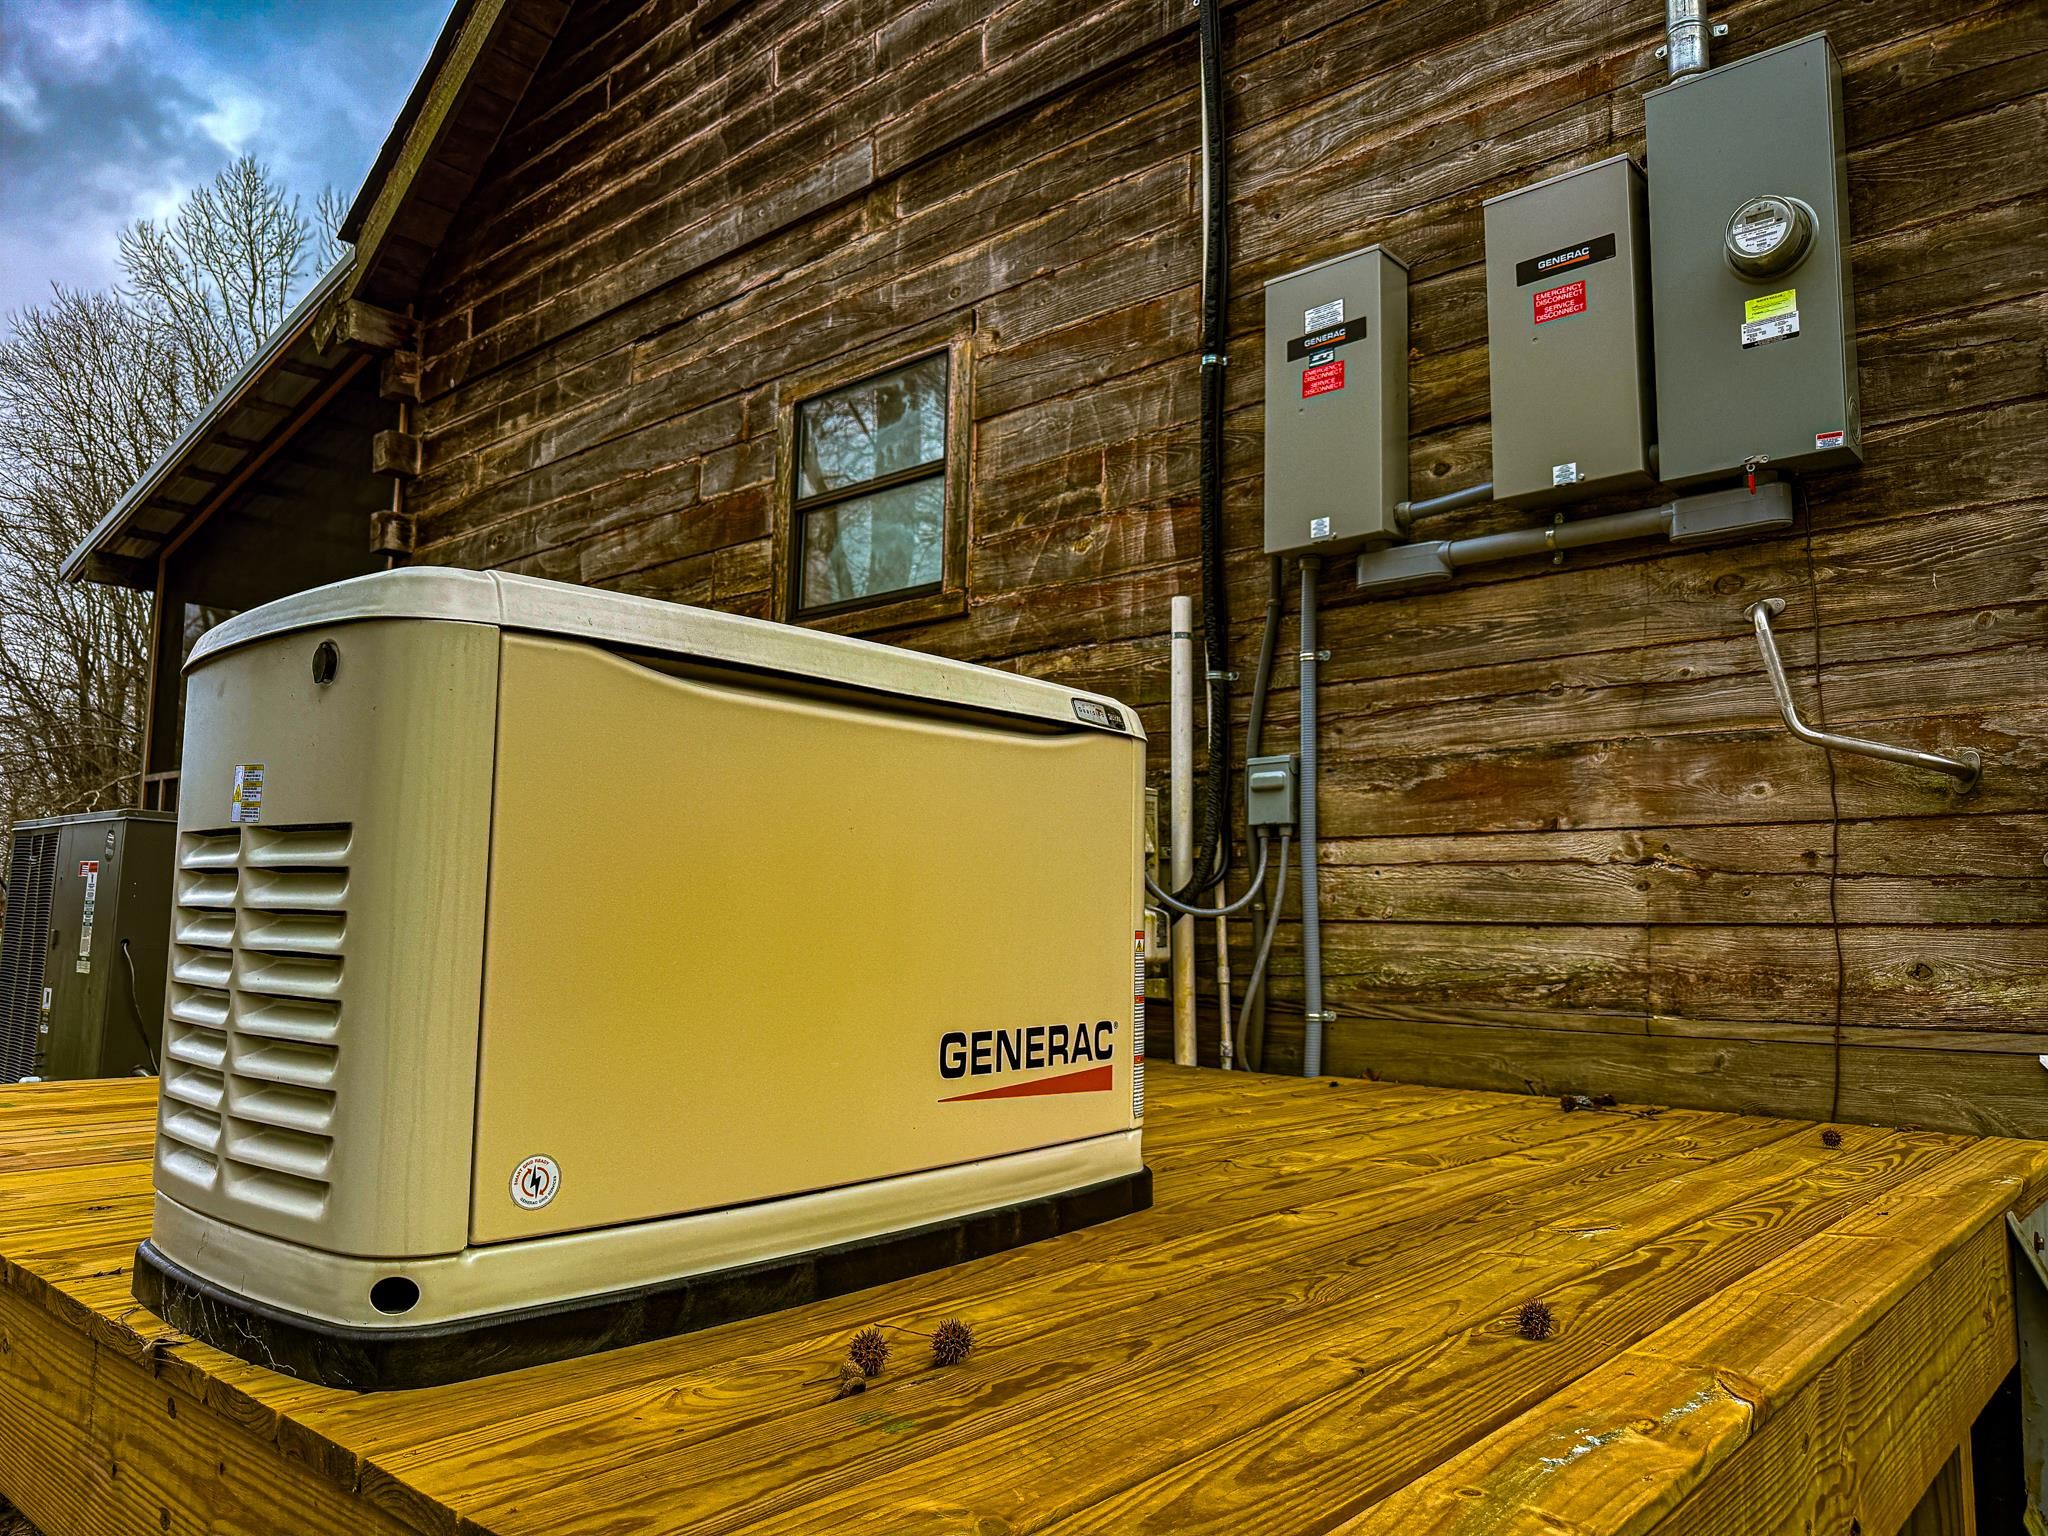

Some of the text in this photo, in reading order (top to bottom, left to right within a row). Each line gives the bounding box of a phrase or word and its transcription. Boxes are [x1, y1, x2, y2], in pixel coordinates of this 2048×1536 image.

[1538, 247, 1590, 269] GENERAC
[1535, 283, 1582, 300] EMERGENCY
[1536, 289, 1583, 307] DISCONNECT
[1536, 304, 1584, 322] DISCONNECT
[1544, 299, 1575, 313] SERVICE
[1304, 328, 1346, 347] GENERAC
[1304, 368, 1342, 383] DISCONNECT
[1304, 381, 1342, 396] DISCONNECT
[939, 1020, 1113, 1079] GENERAC
